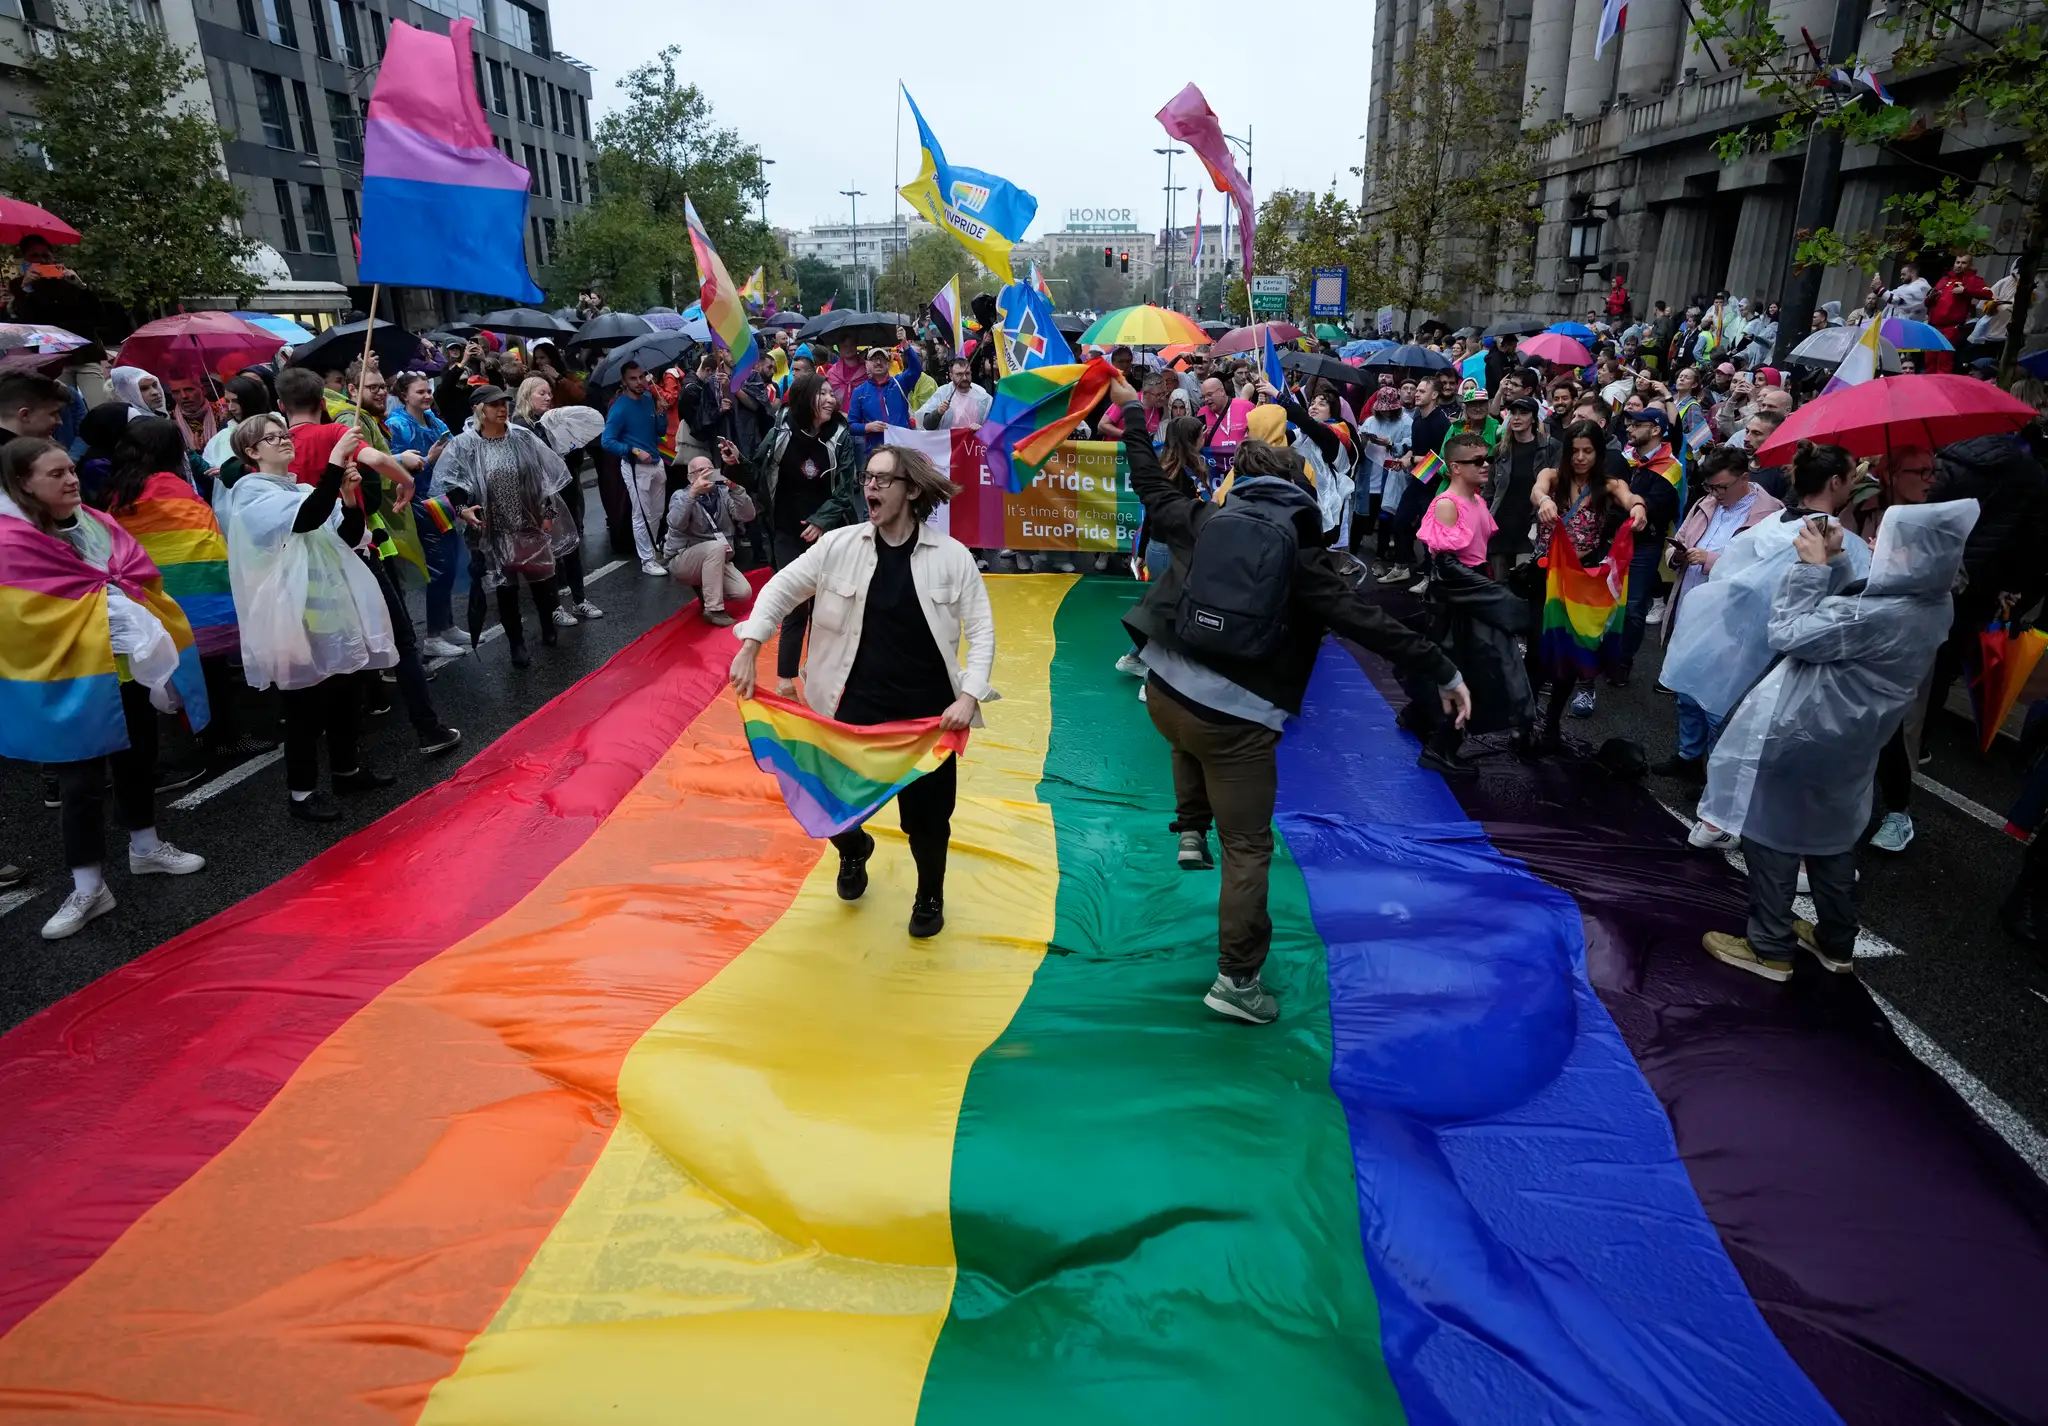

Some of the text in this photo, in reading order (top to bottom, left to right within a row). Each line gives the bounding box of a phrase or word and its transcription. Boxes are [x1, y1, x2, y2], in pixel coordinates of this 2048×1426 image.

[945, 208, 987, 239] IVPRIDE
[1069, 208, 1132, 222] HONOR
[963, 440, 988, 457] Vre
[1066, 452, 1129, 469] prome
[1102, 477, 1116, 492] u
[1007, 504, 1026, 517] It's
[1030, 504, 1060, 518] time
[1063, 505, 1081, 519] for
[1085, 508, 1137, 525] change.
[1022, 521, 1110, 540] EuroPride
